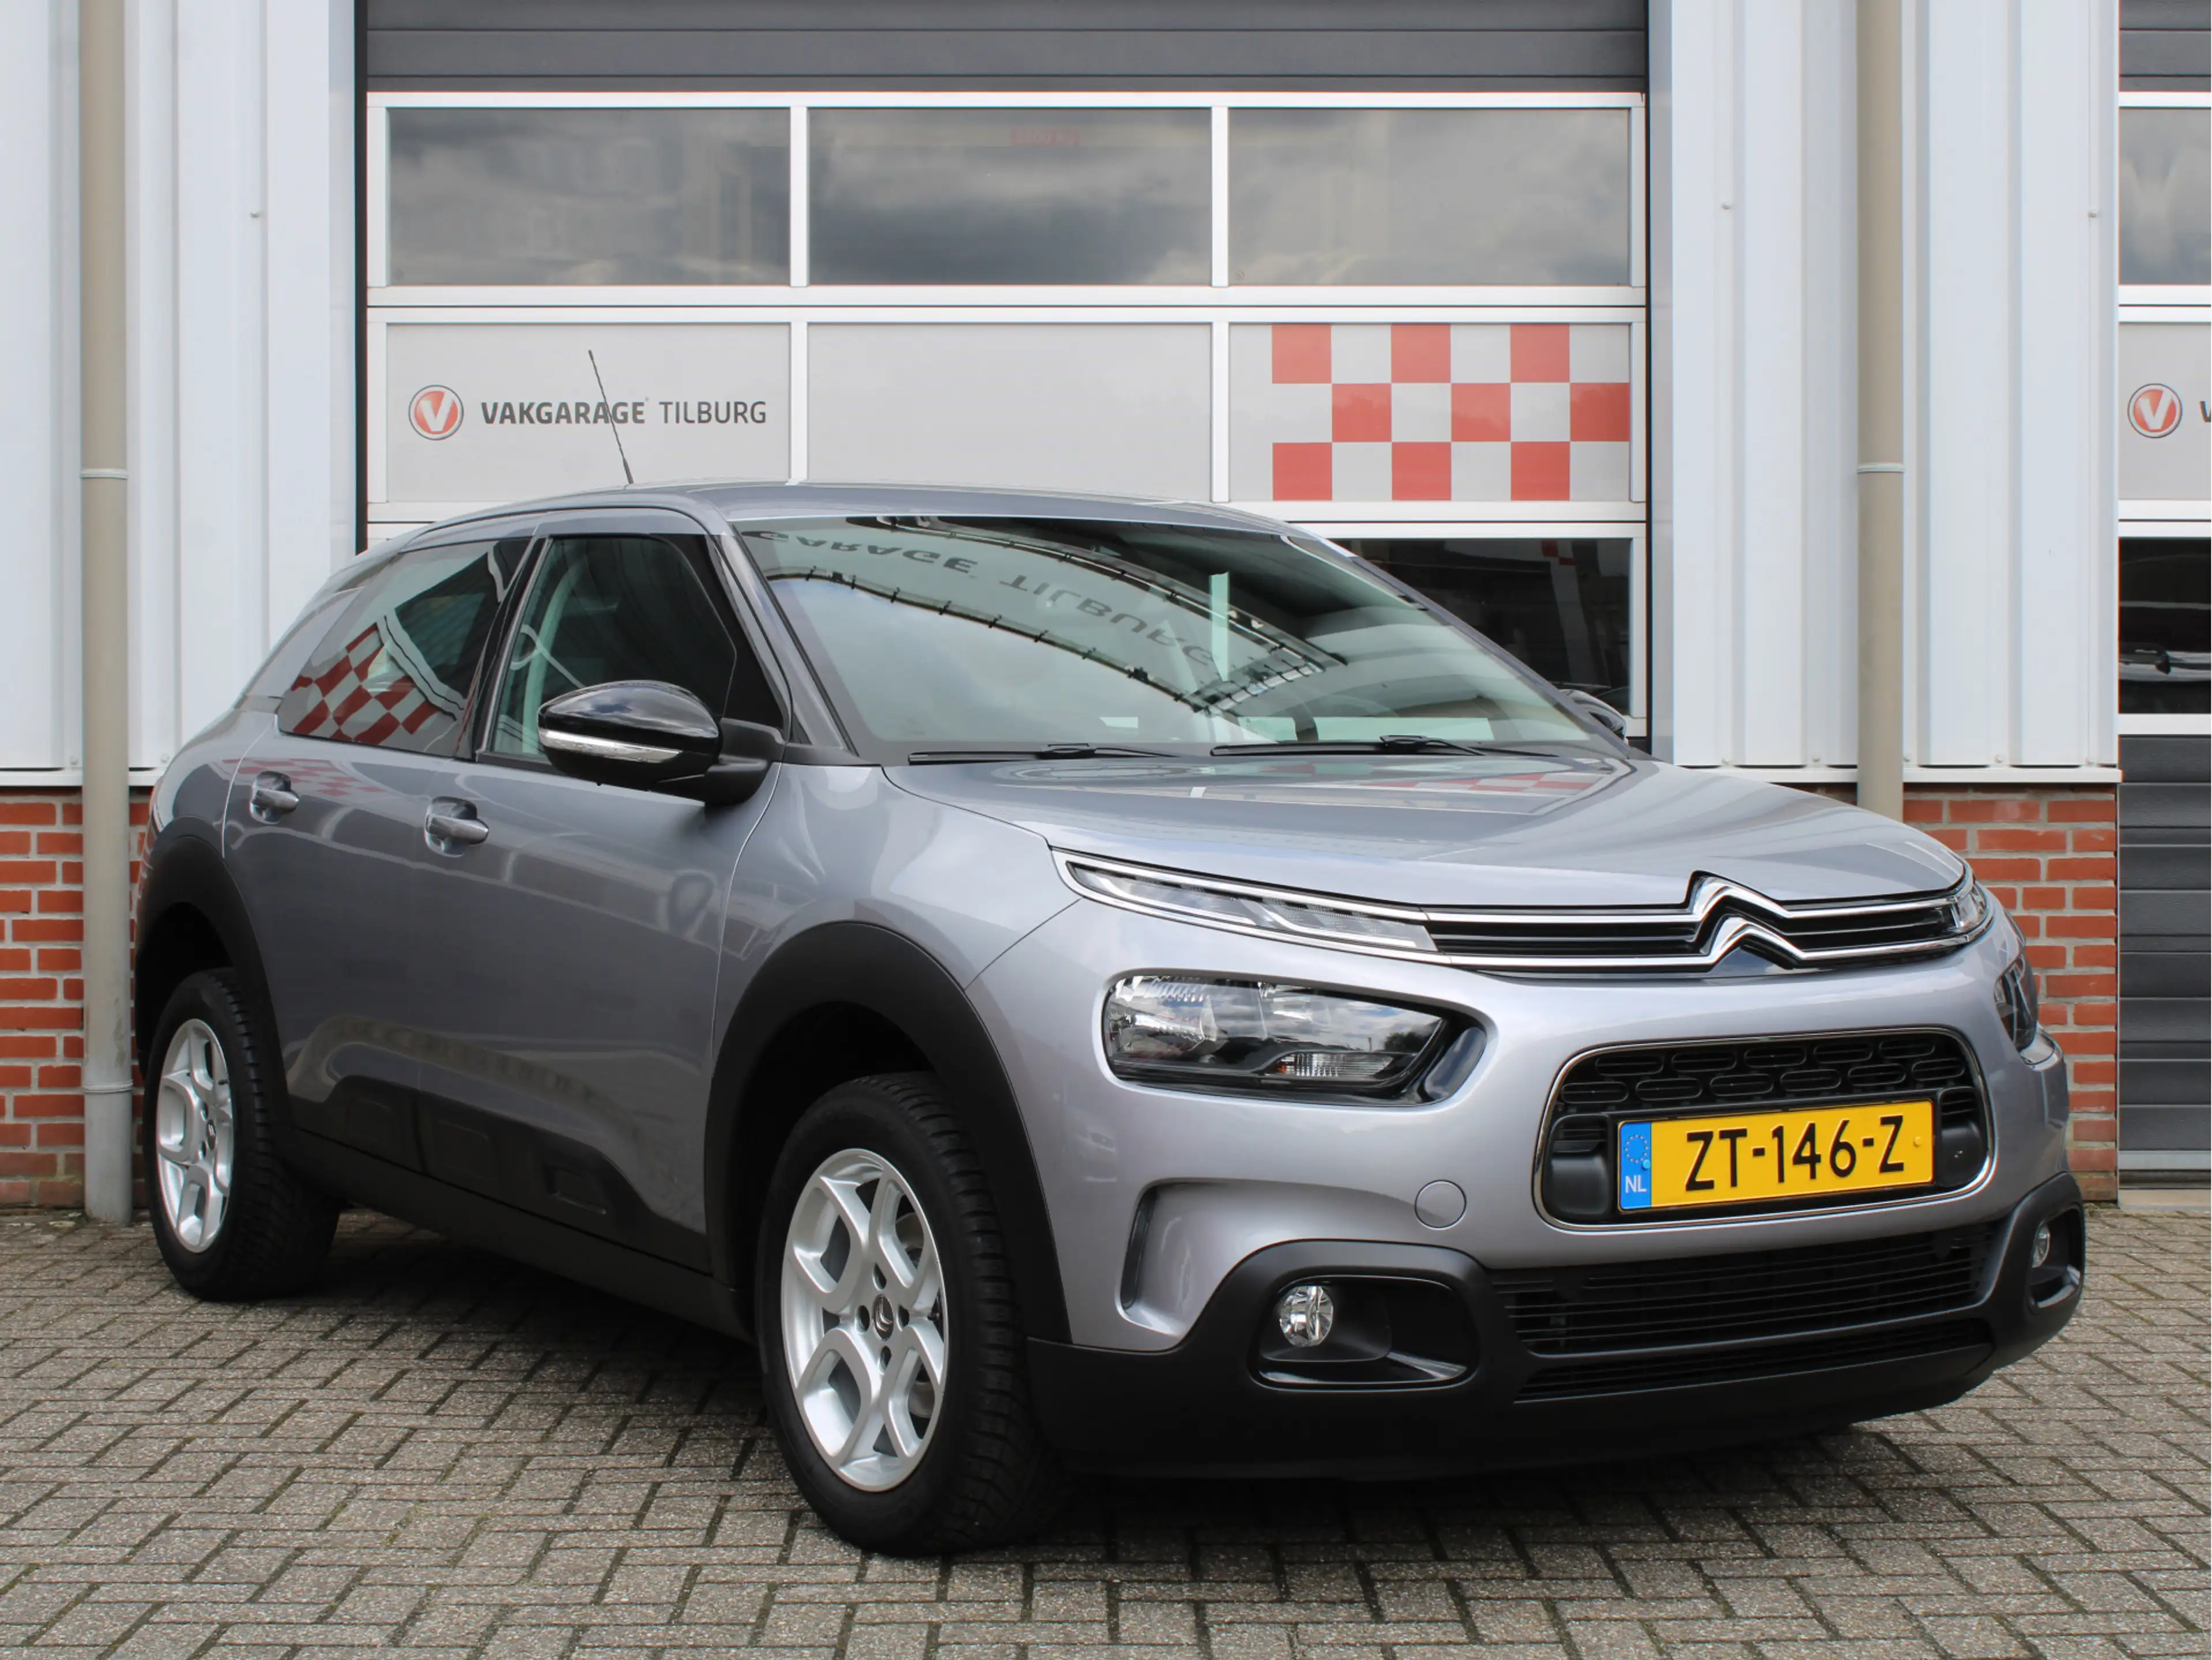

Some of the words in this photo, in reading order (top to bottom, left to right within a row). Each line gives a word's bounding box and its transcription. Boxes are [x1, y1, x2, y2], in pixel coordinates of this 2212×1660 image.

[481, 401, 646, 425] VAKGARAGE
[659, 400, 767, 424] TILBURG
[1685, 1114, 1905, 1192] ZT-146-Z
[1625, 1174, 1647, 1194] NL
